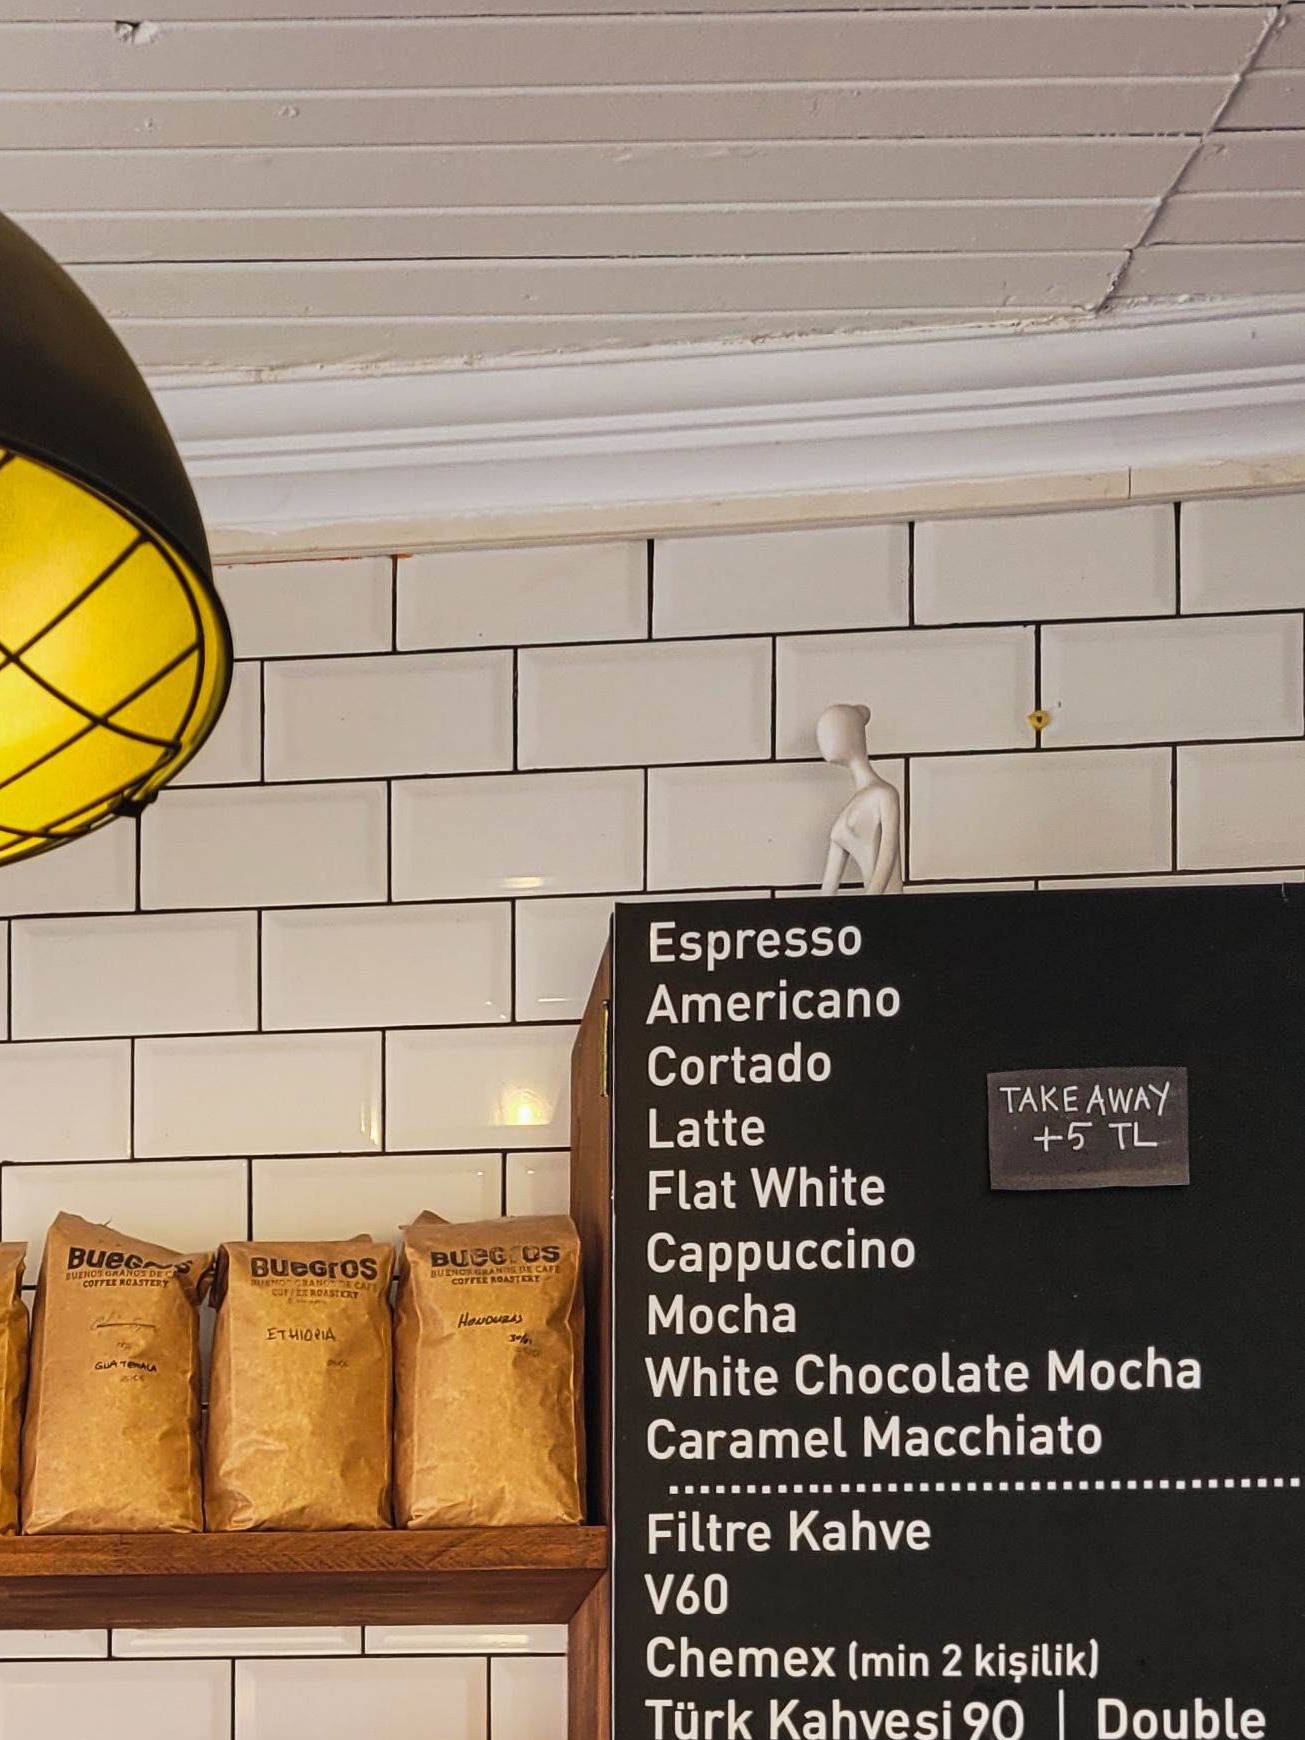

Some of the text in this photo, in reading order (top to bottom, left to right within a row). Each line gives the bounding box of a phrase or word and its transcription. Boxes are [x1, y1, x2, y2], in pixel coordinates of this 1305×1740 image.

[649, 921, 862, 972] Espresso
[645, 979, 900, 1025] Americano
[648, 1041, 831, 1087] Cortado
[649, 1108, 765, 1149] Latte
[1033, 1121, 1159, 1152] +5 TL
[648, 1165, 885, 1211] Flat White
[647, 1227, 915, 1283] Cappuccino
[648, 1292, 796, 1335] Mocha
[644, 1346, 1201, 1398] White Chocolate Mocha
[647, 1413, 1102, 1461] Caramel Macchiato
[648, 1509, 931, 1555] Filtre Kahve
[644, 1573, 728, 1615] V60
[646, 1636, 1099, 1684] Chemex (min 2 kişilik)
[644, 1699, 753, 1740] Türk
[1097, 1697, 1266, 1740] Double
